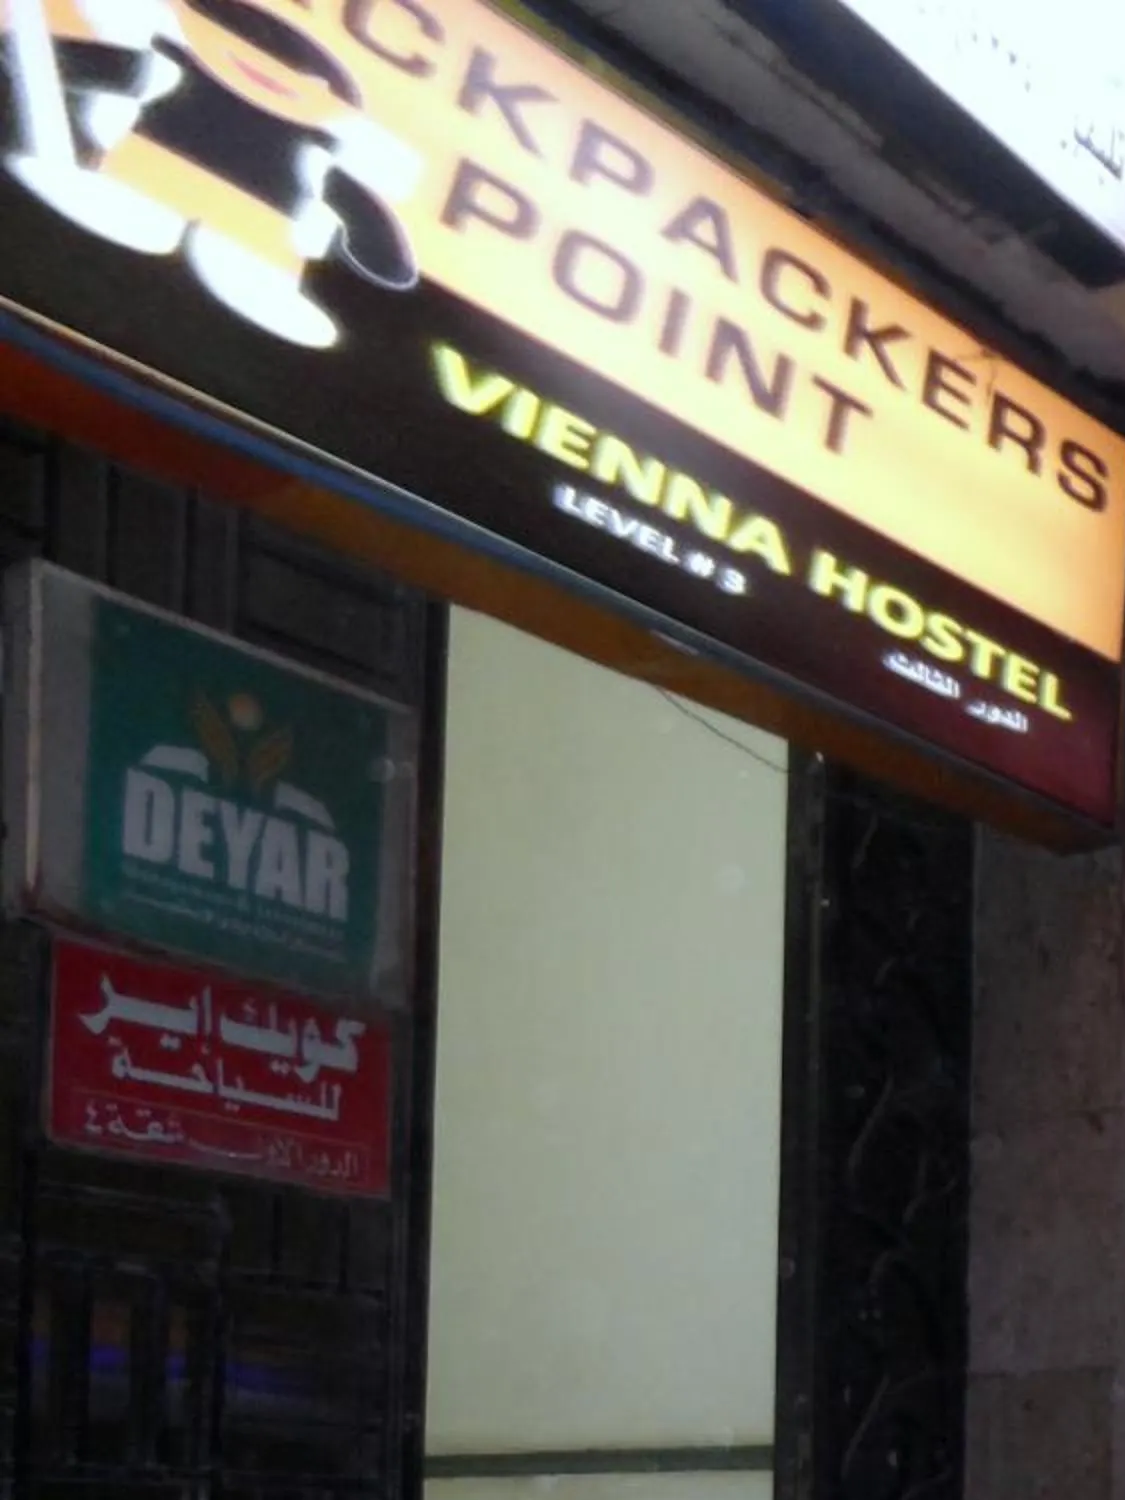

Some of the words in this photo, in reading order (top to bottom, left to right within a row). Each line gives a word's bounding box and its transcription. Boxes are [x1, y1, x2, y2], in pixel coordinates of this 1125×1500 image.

[290, 0, 1111, 514] CKPACKERS
[439, 156, 874, 458] POINT
[431, 340, 792, 577] VIENNA
[809, 549, 1074, 721] HOSTEL
[553, 482, 681, 565] LEVEL
[719, 566, 747, 595] 3
[121, 766, 351, 922] DEYAR
[109, 1037, 343, 1122] للسياحة
